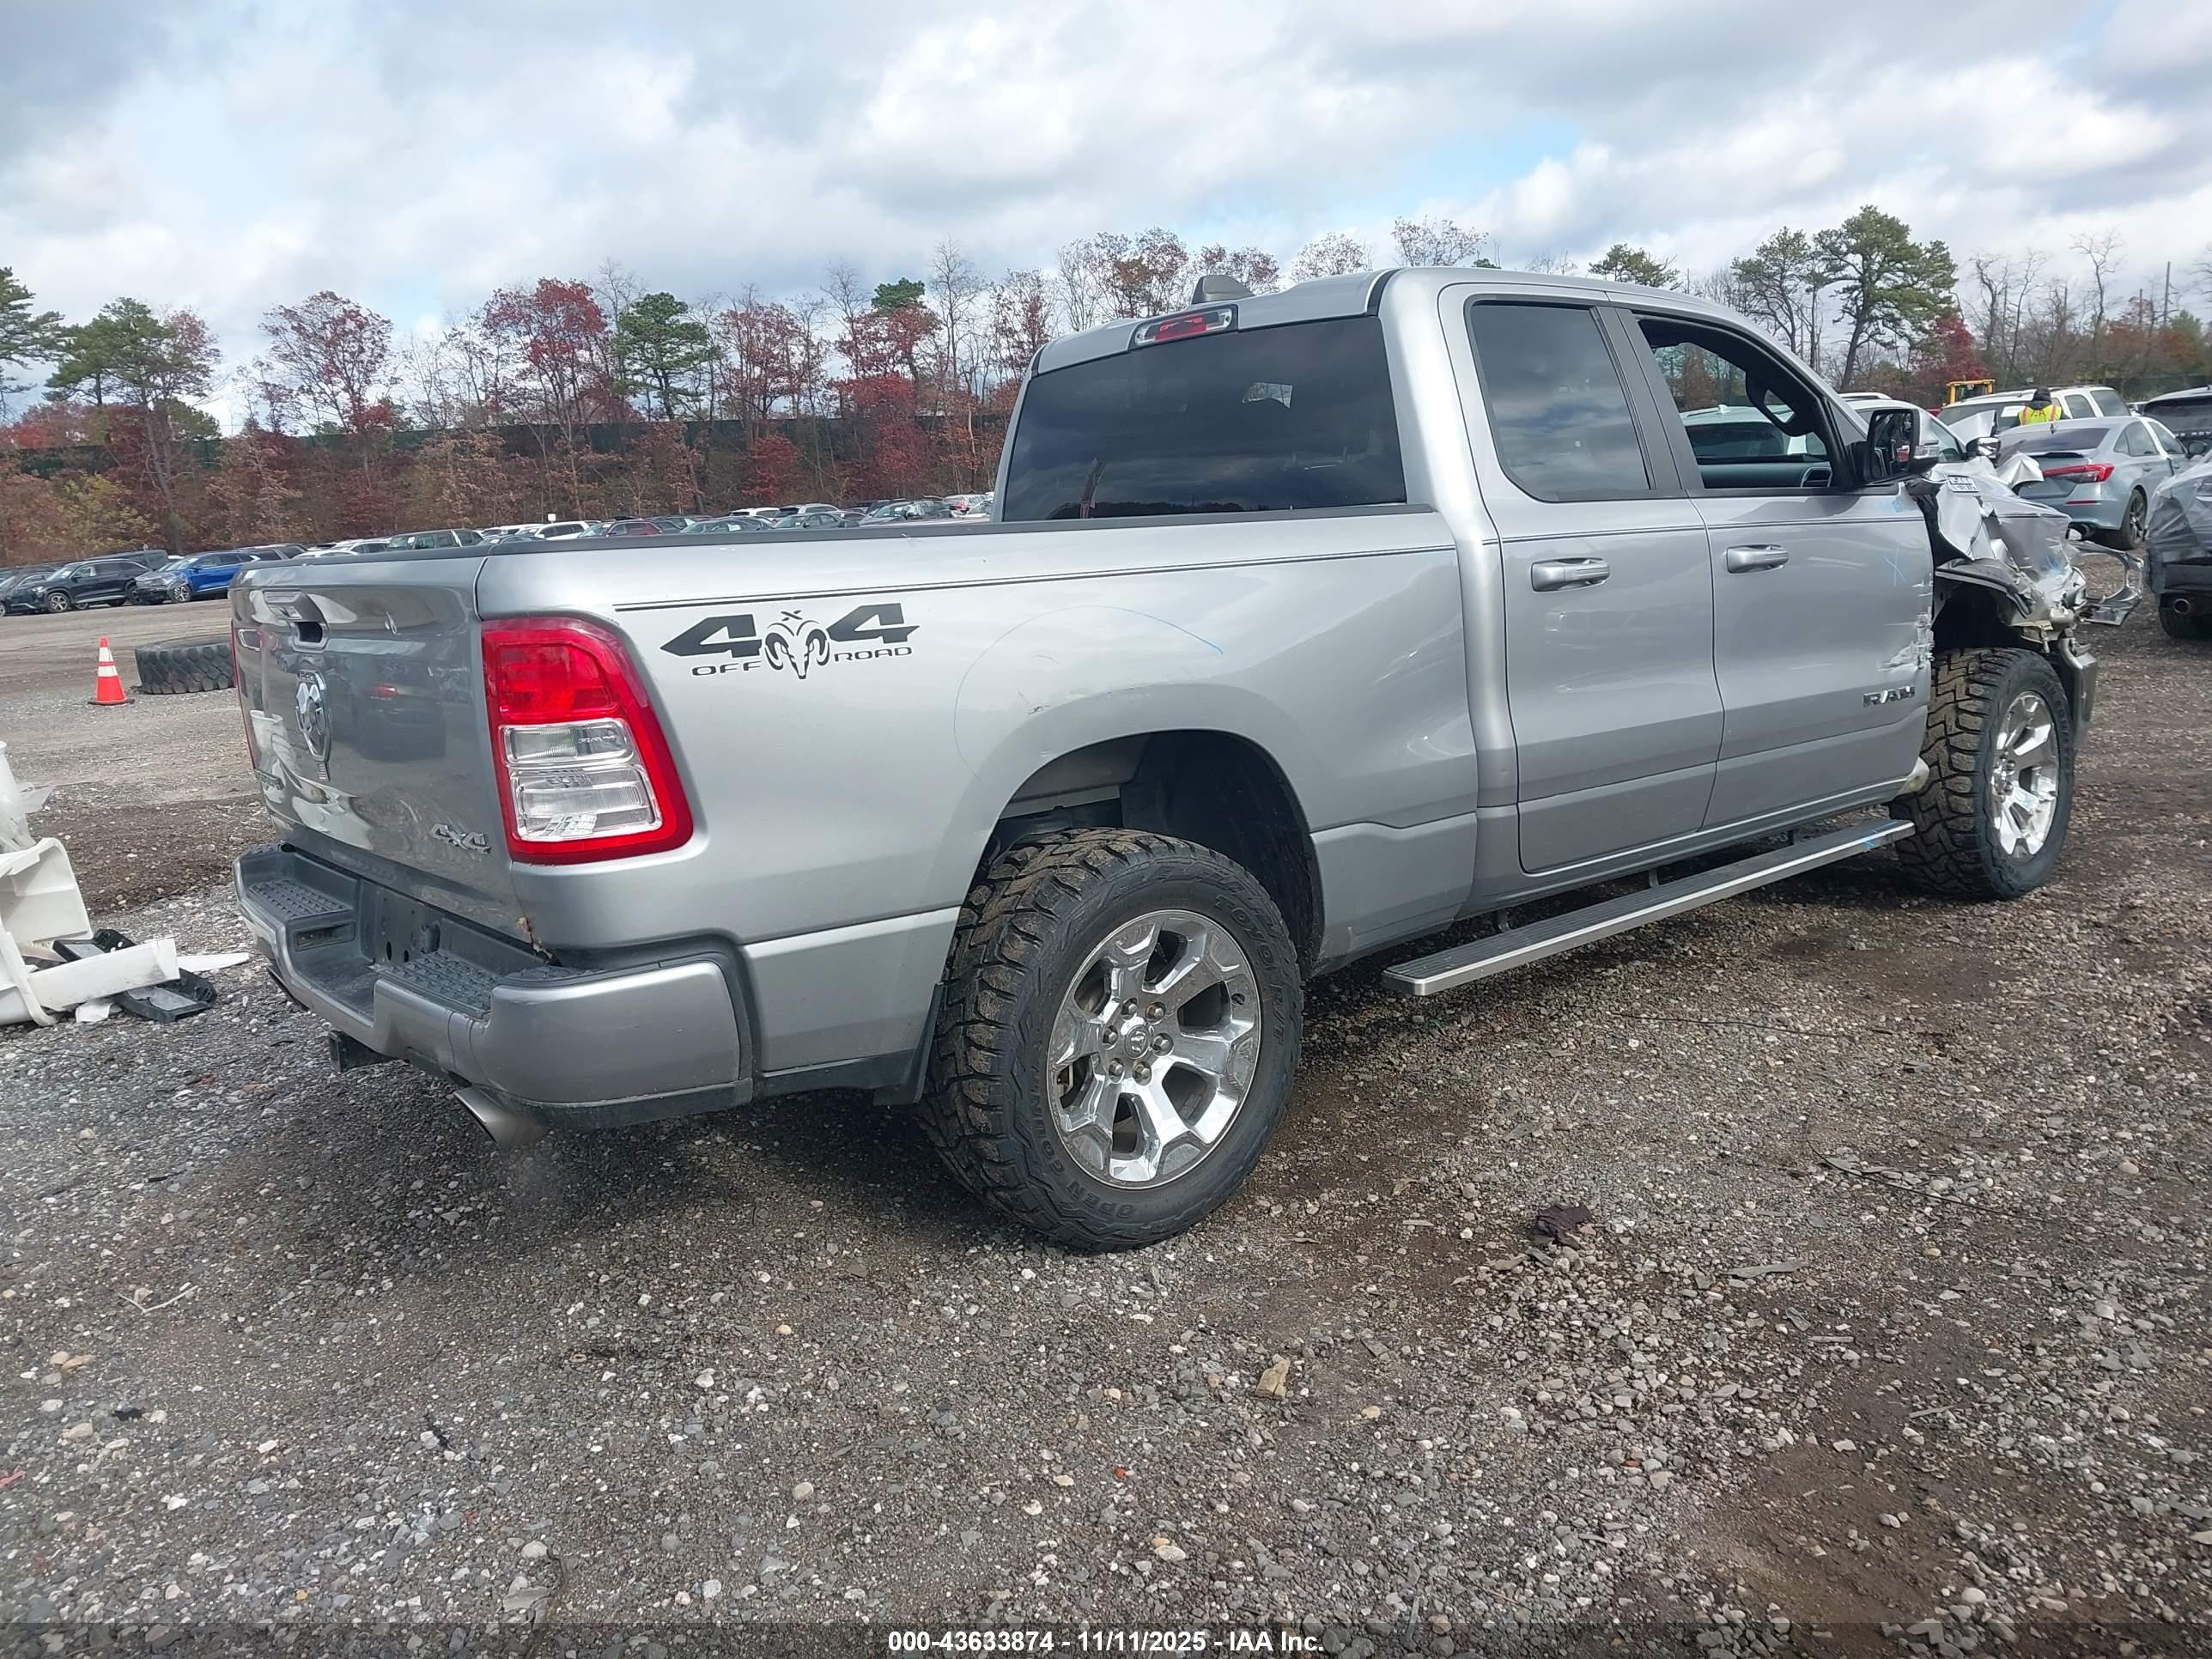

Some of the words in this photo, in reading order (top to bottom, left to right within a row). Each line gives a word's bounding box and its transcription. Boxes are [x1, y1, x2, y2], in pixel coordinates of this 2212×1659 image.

[691, 660, 763, 677] OFF
[834, 646, 913, 662] ROAD
[1863, 685, 1916, 708] RAM
[1215, 893, 1274, 967] TOYO
[1270, 983, 1286, 1045] R/T
[1066, 1180, 1134, 1218] OPEN
